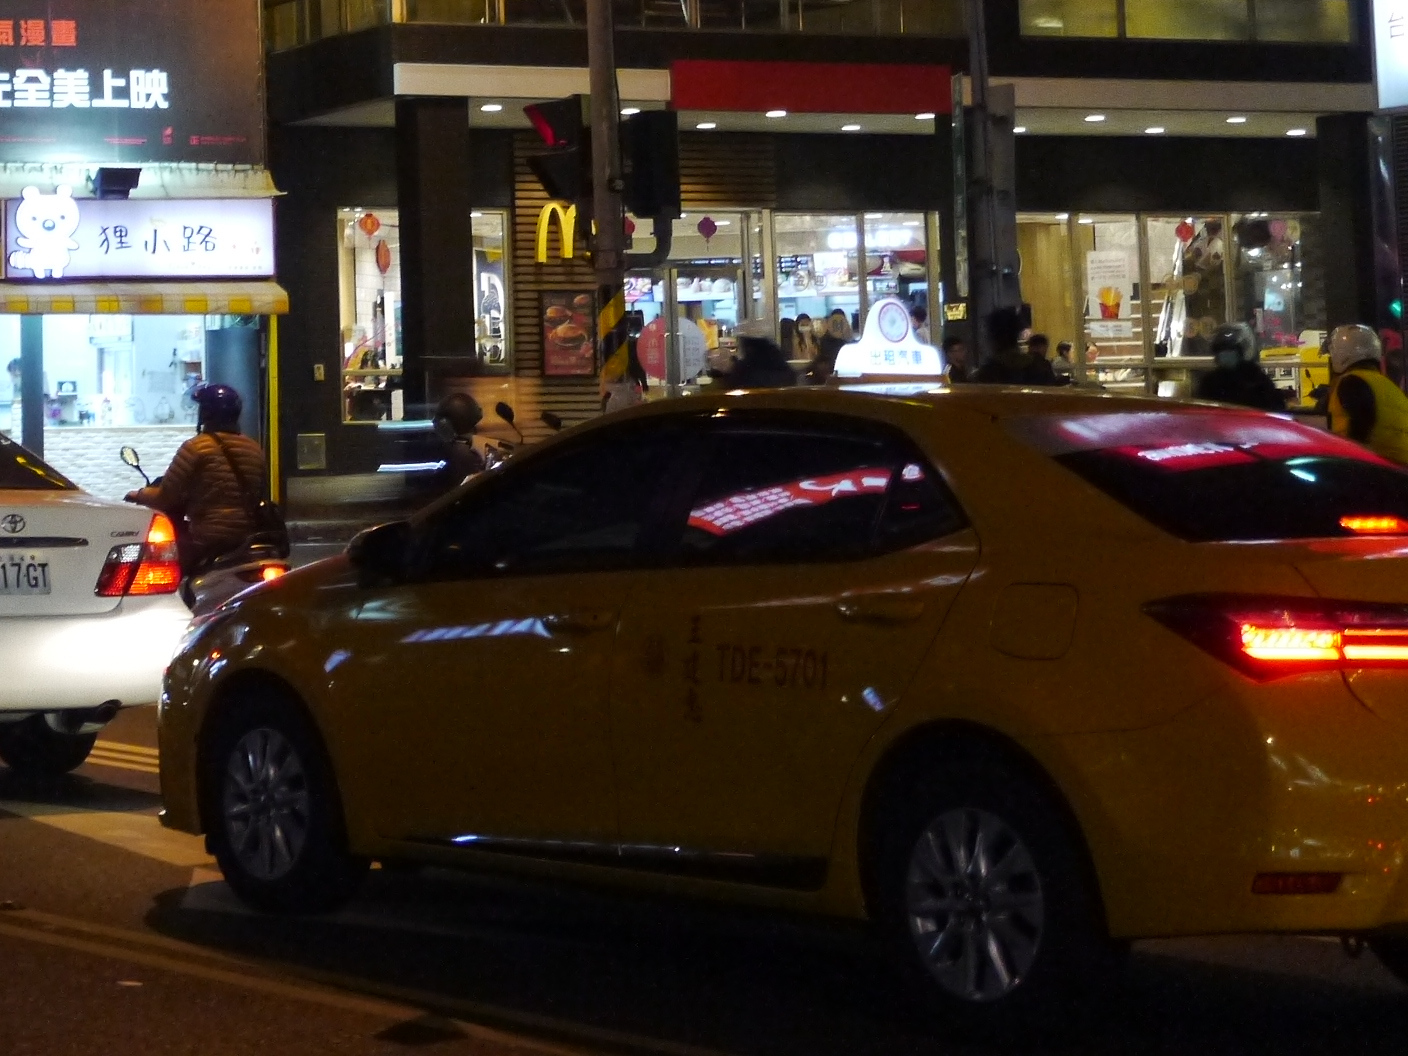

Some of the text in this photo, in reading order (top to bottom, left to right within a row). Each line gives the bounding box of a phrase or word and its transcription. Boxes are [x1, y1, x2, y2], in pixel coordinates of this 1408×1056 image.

[98, 225, 218, 255] 狸小路
[869, 349, 922, 365] 出租汽車
